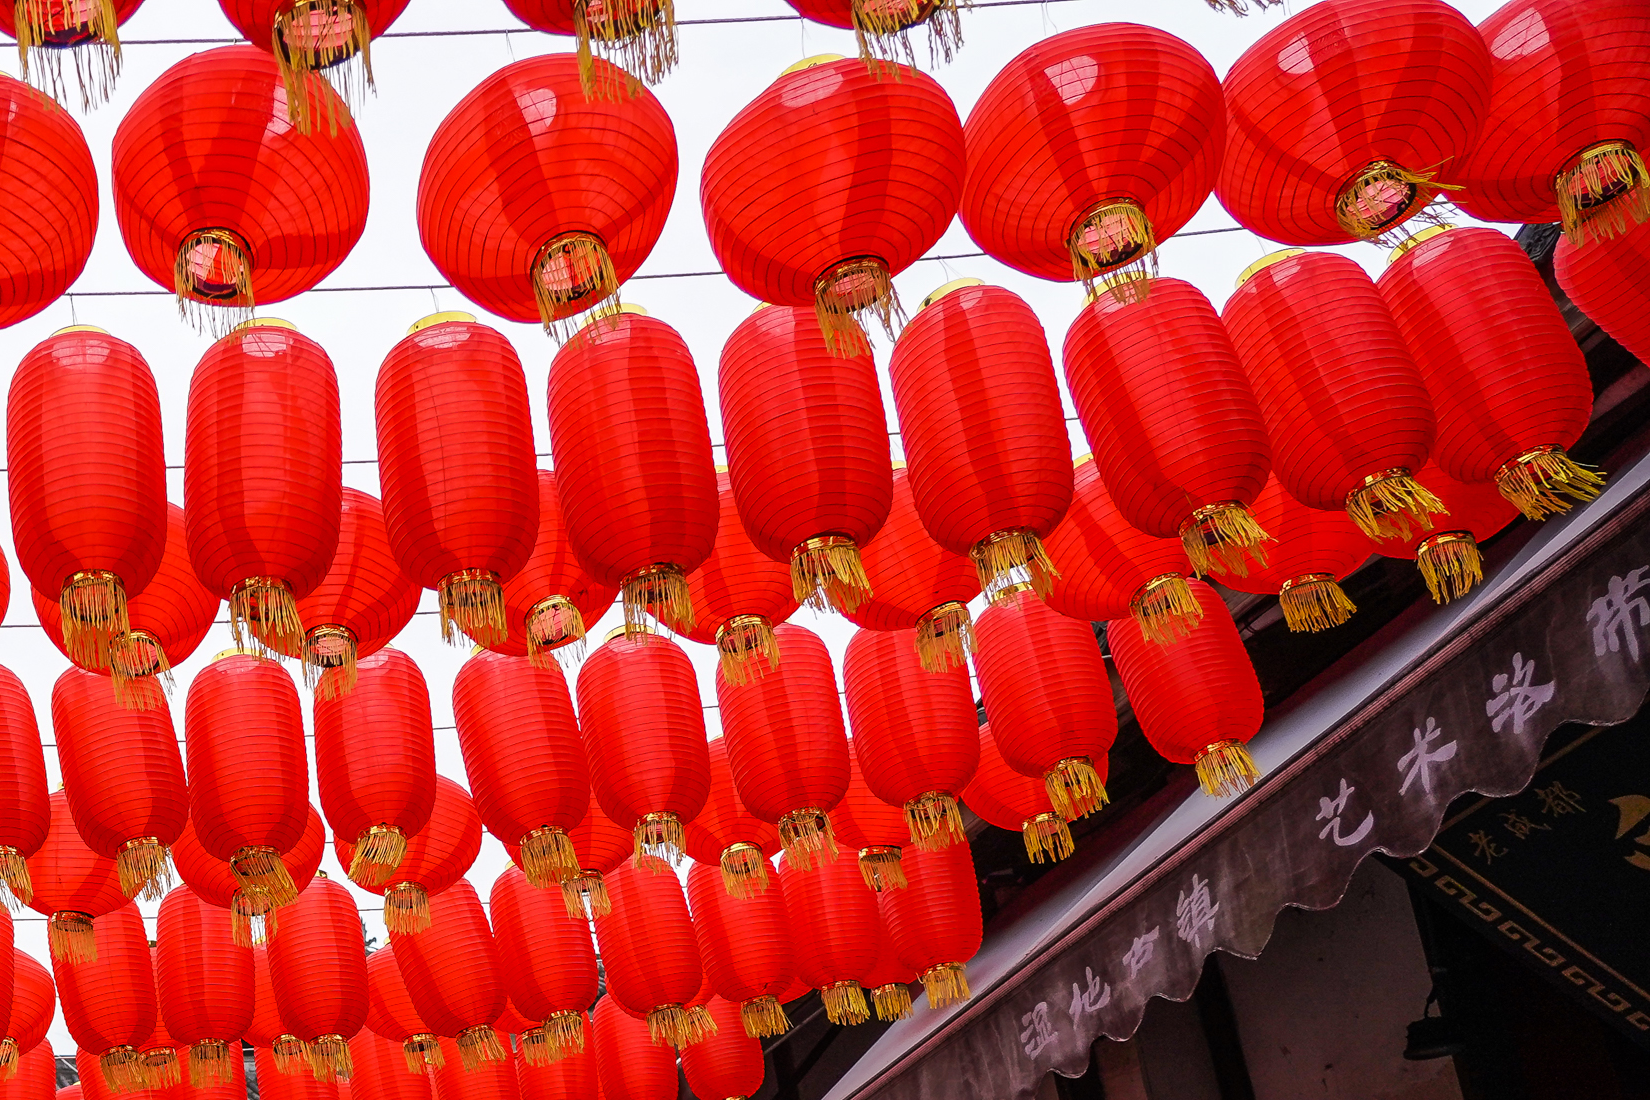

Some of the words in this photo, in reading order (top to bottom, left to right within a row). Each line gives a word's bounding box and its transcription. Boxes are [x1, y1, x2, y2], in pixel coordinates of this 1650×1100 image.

[1315, 564, 1650, 846] 艺术洛带
[1467, 780, 1587, 866] 老成都
